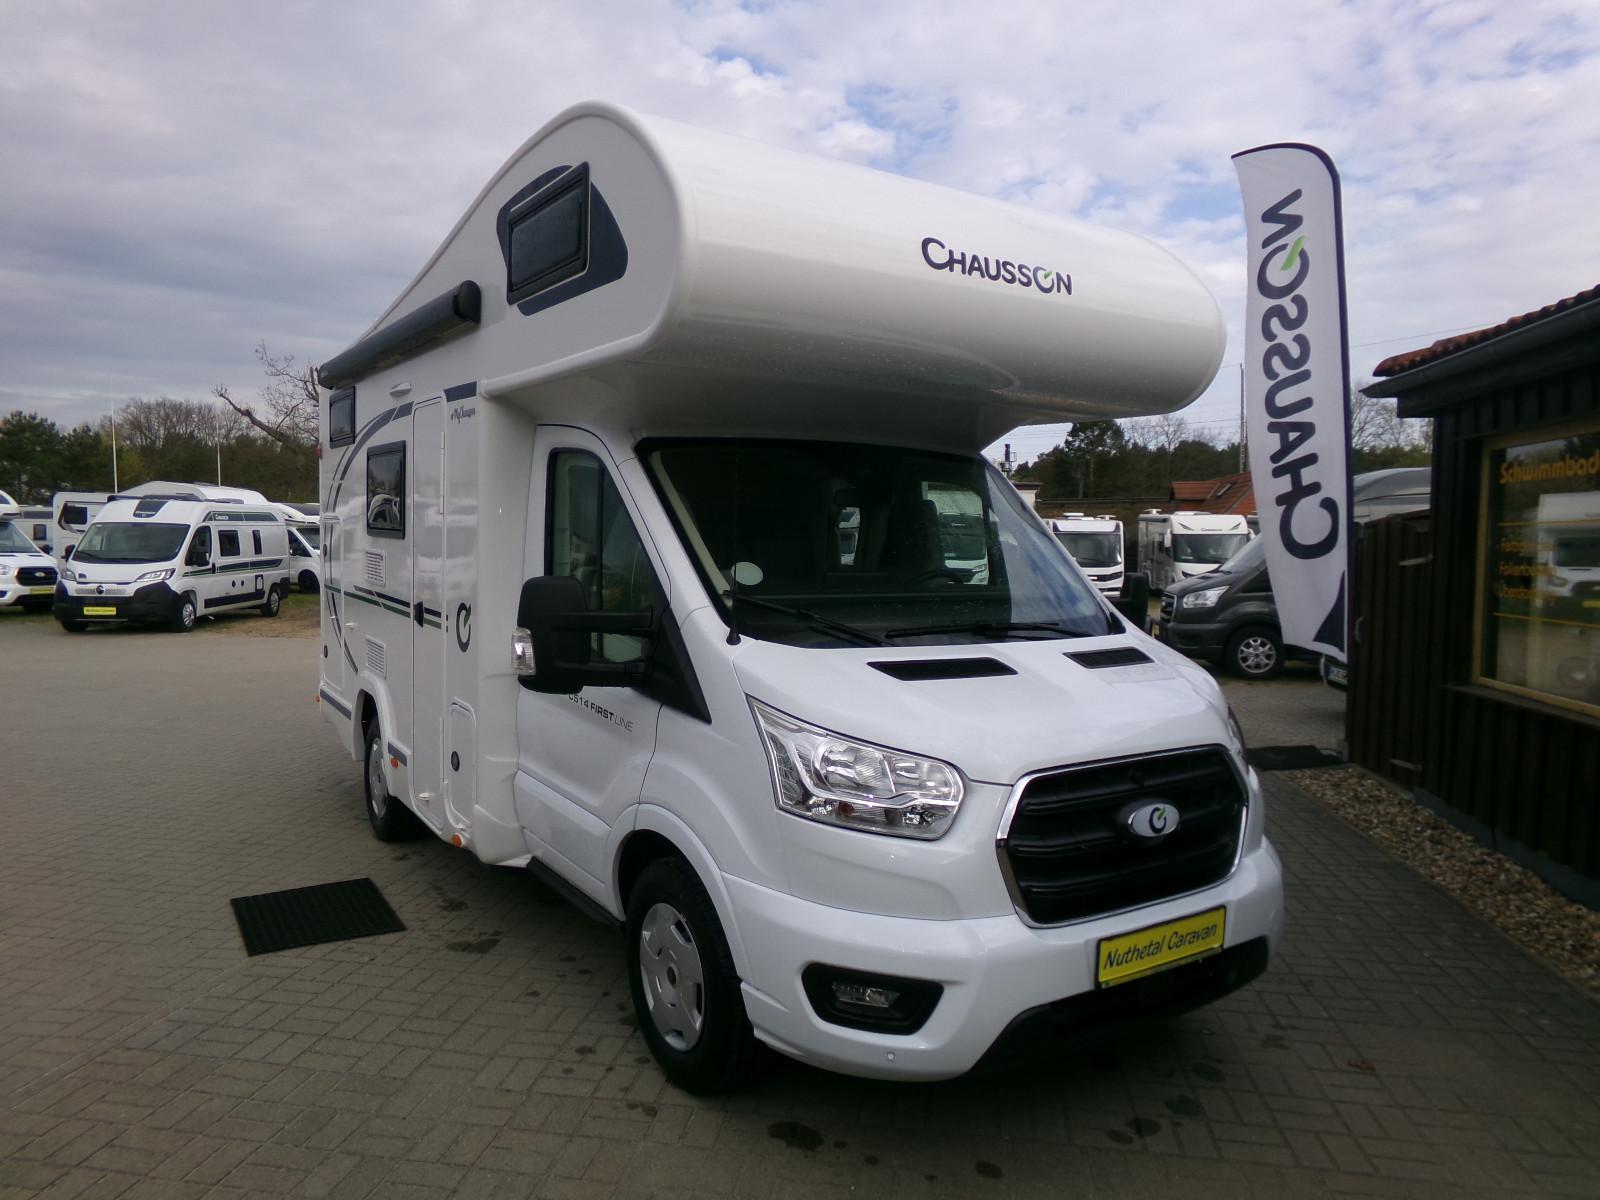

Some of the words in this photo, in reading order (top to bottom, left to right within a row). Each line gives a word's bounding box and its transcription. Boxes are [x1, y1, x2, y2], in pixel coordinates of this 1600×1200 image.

[921, 237, 1073, 296] CHAUSSON
[1103, 935, 1166, 970] Nuthetal
[1167, 924, 1218, 951] Caravan
